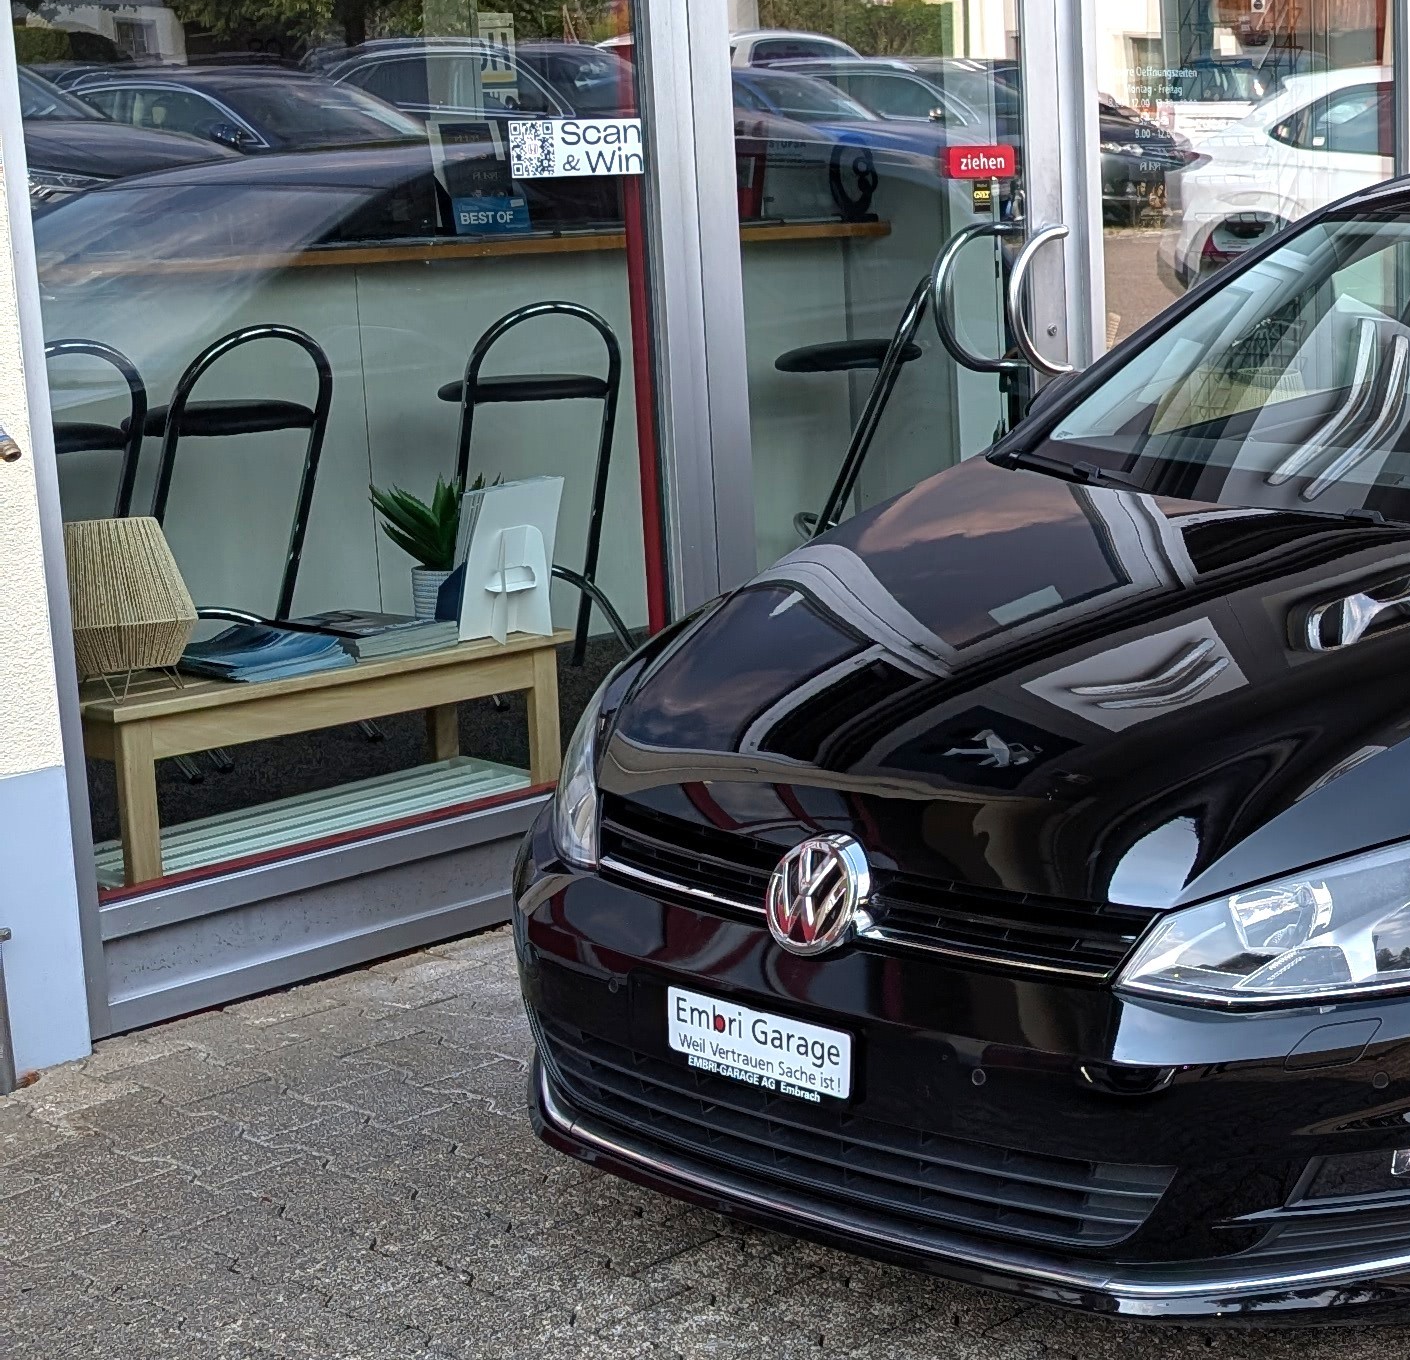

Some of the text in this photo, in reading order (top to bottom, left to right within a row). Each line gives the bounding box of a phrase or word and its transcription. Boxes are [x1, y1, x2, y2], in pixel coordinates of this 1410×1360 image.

[1136, 66, 1198, 79] Oeffnungszeiten
[1158, 84, 1183, 96] Freitag
[560, 121, 641, 146] Scan
[1134, 128, 1151, 139] 9.00
[562, 146, 643, 173] & Win
[960, 152, 1005, 170] ziehen
[460, 211, 514, 225] BEST OF
[676, 996, 840, 1069] Embri Garage
[678, 1032, 706, 1054] Weil
[710, 1041, 774, 1074] Vertrauen
[779, 1061, 816, 1086] Sache
[820, 1072, 835, 1091] ist
[688, 1055, 821, 1103] EMBRI-GARAGE AG Embrach
